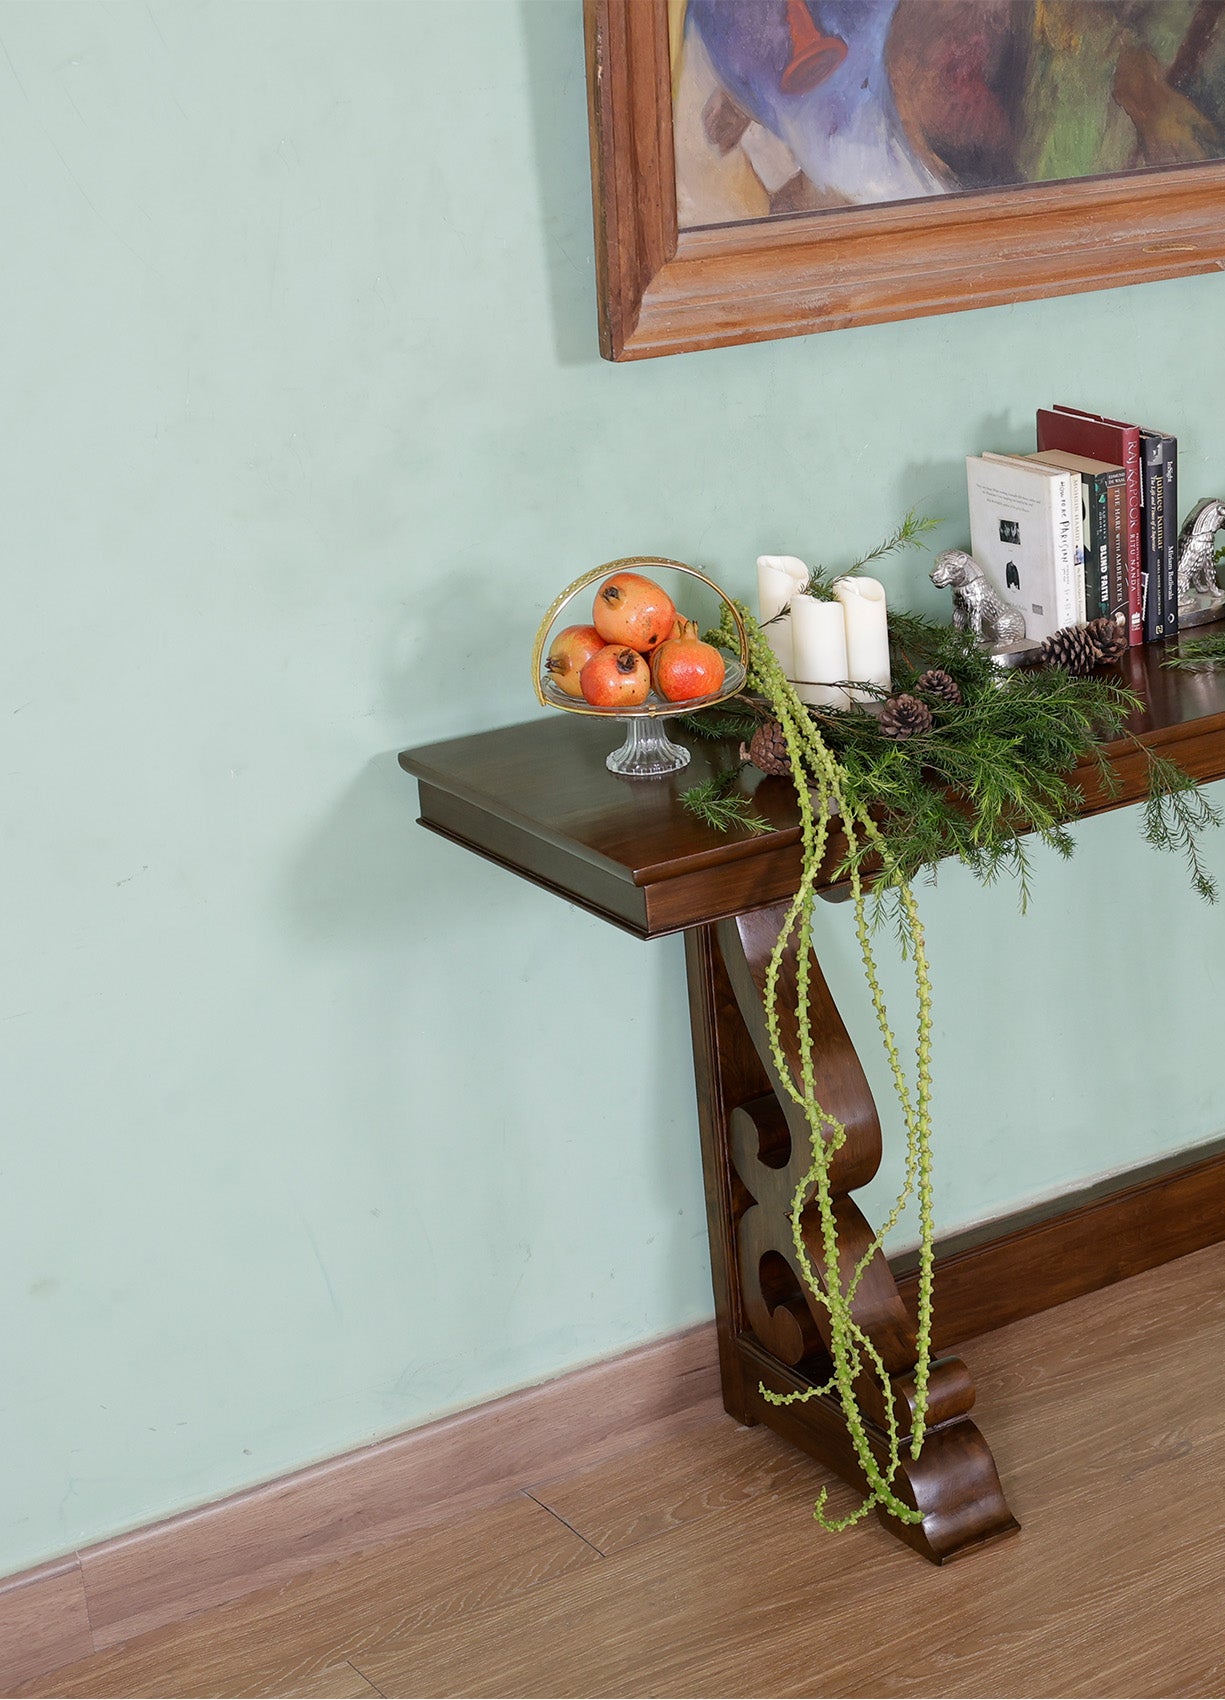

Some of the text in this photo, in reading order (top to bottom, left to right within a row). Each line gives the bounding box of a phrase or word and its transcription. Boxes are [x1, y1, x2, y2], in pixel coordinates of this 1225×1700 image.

[1127, 440, 1138, 529] RAJ KAPOOR
[1059, 521, 1070, 563] PARISIAN
[1100, 544, 1108, 573] BLIND
